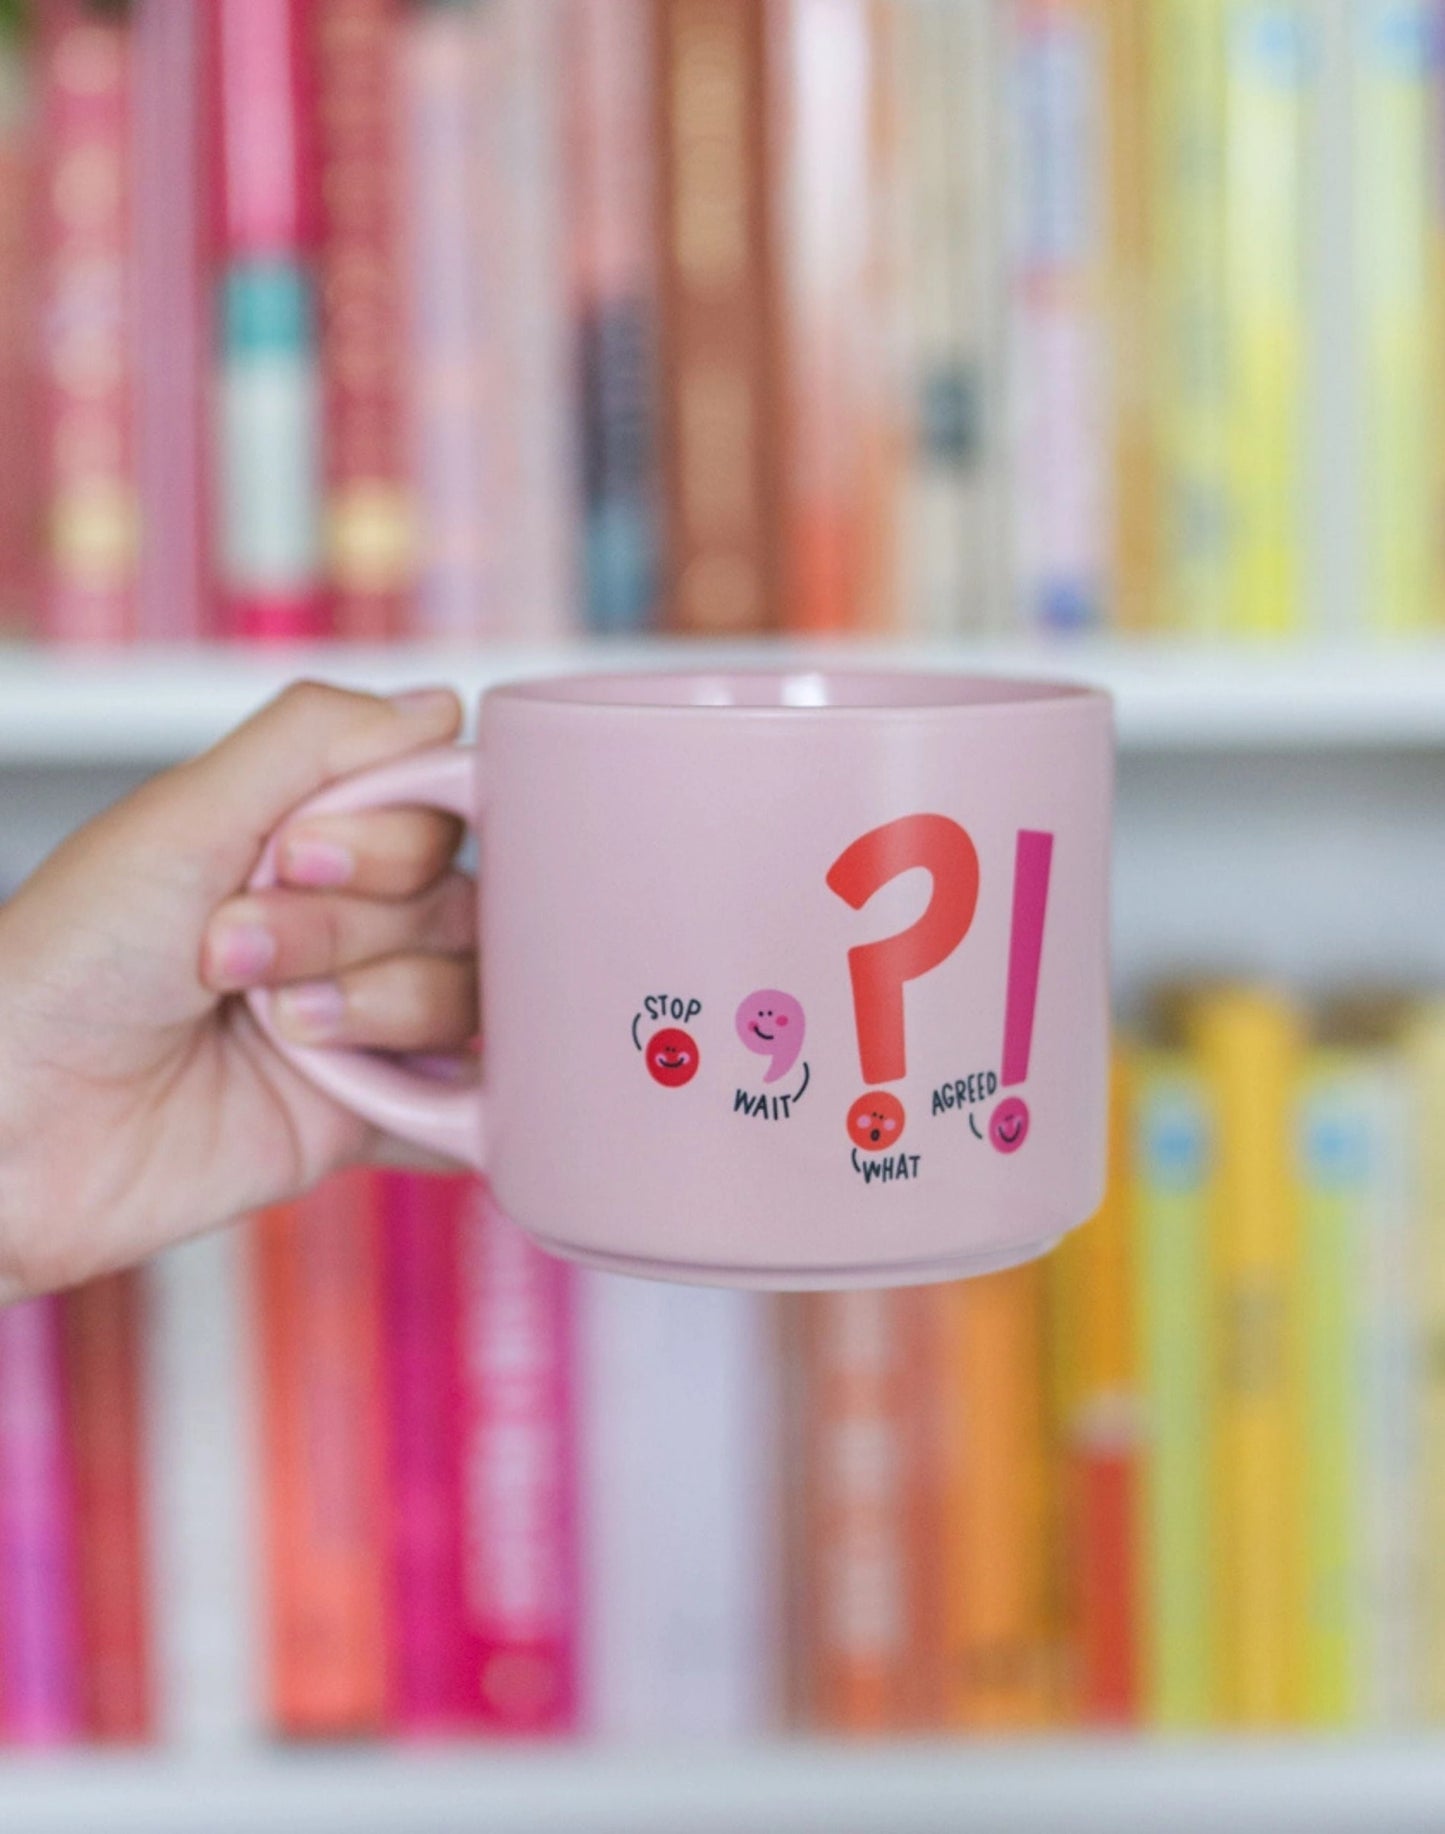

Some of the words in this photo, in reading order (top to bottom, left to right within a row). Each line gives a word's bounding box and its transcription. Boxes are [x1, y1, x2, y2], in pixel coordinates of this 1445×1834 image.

[643, 994, 702, 1024] STOP
[733, 1088, 792, 1121] WAIT
[931, 1070, 998, 1117] AGREED
[862, 1152, 921, 1185] WHAT
